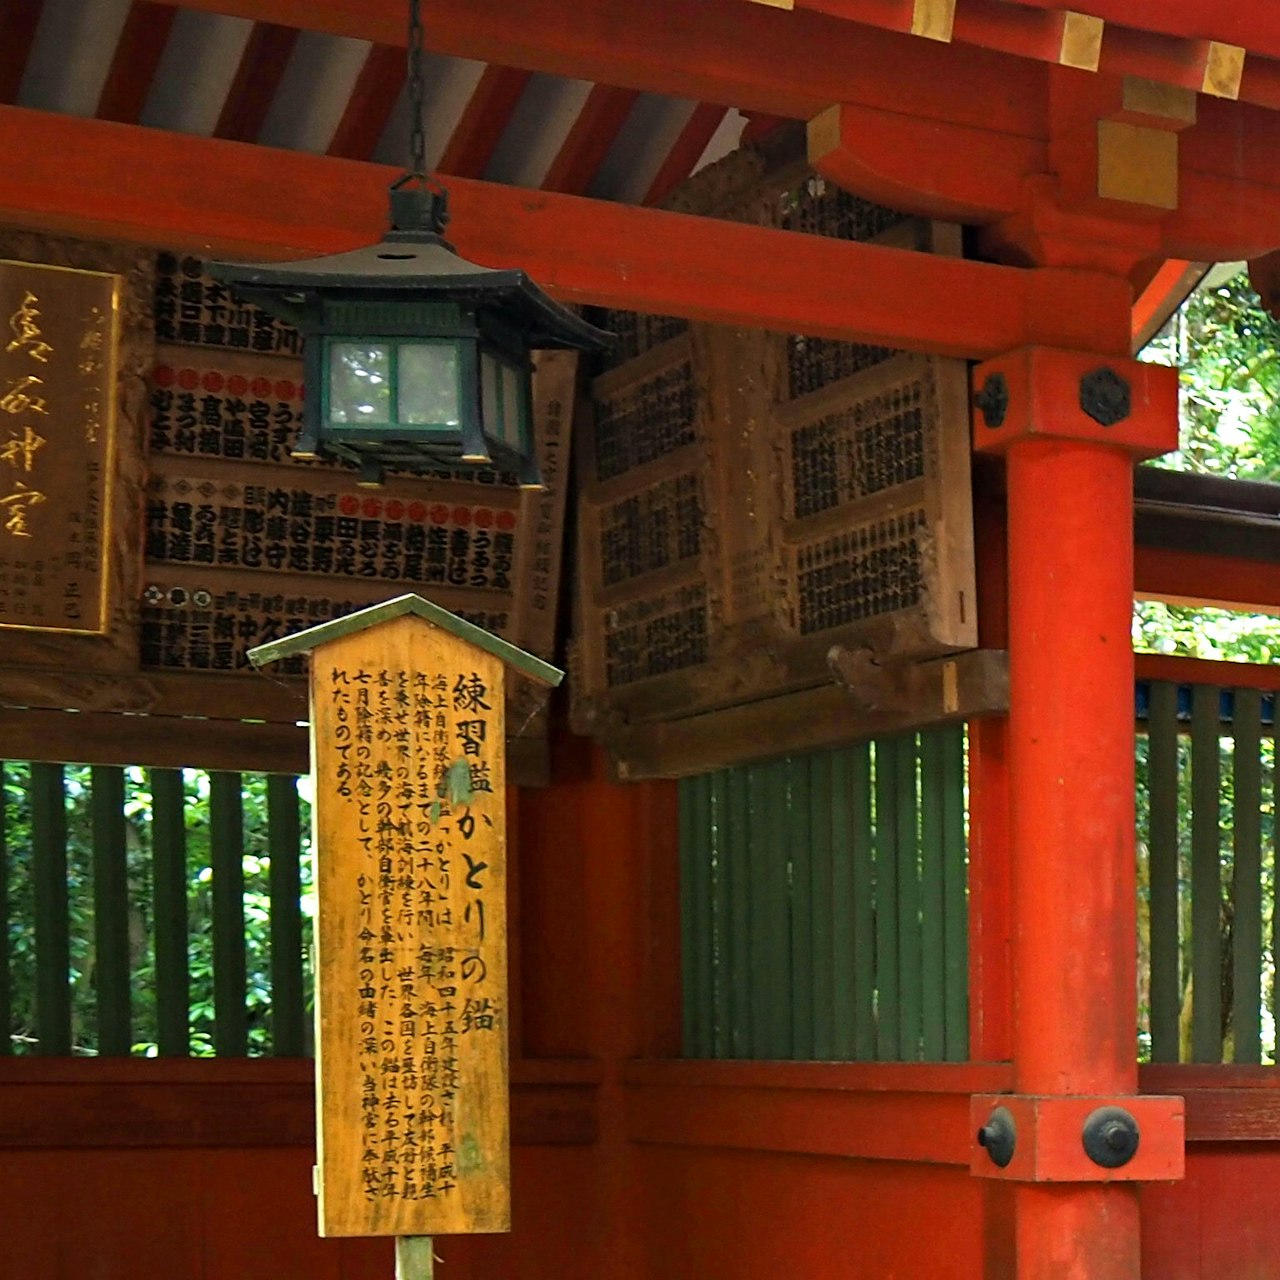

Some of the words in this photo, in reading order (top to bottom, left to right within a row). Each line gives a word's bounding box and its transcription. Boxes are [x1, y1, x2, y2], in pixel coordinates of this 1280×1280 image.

[331, 666, 353, 804] れたものである。
